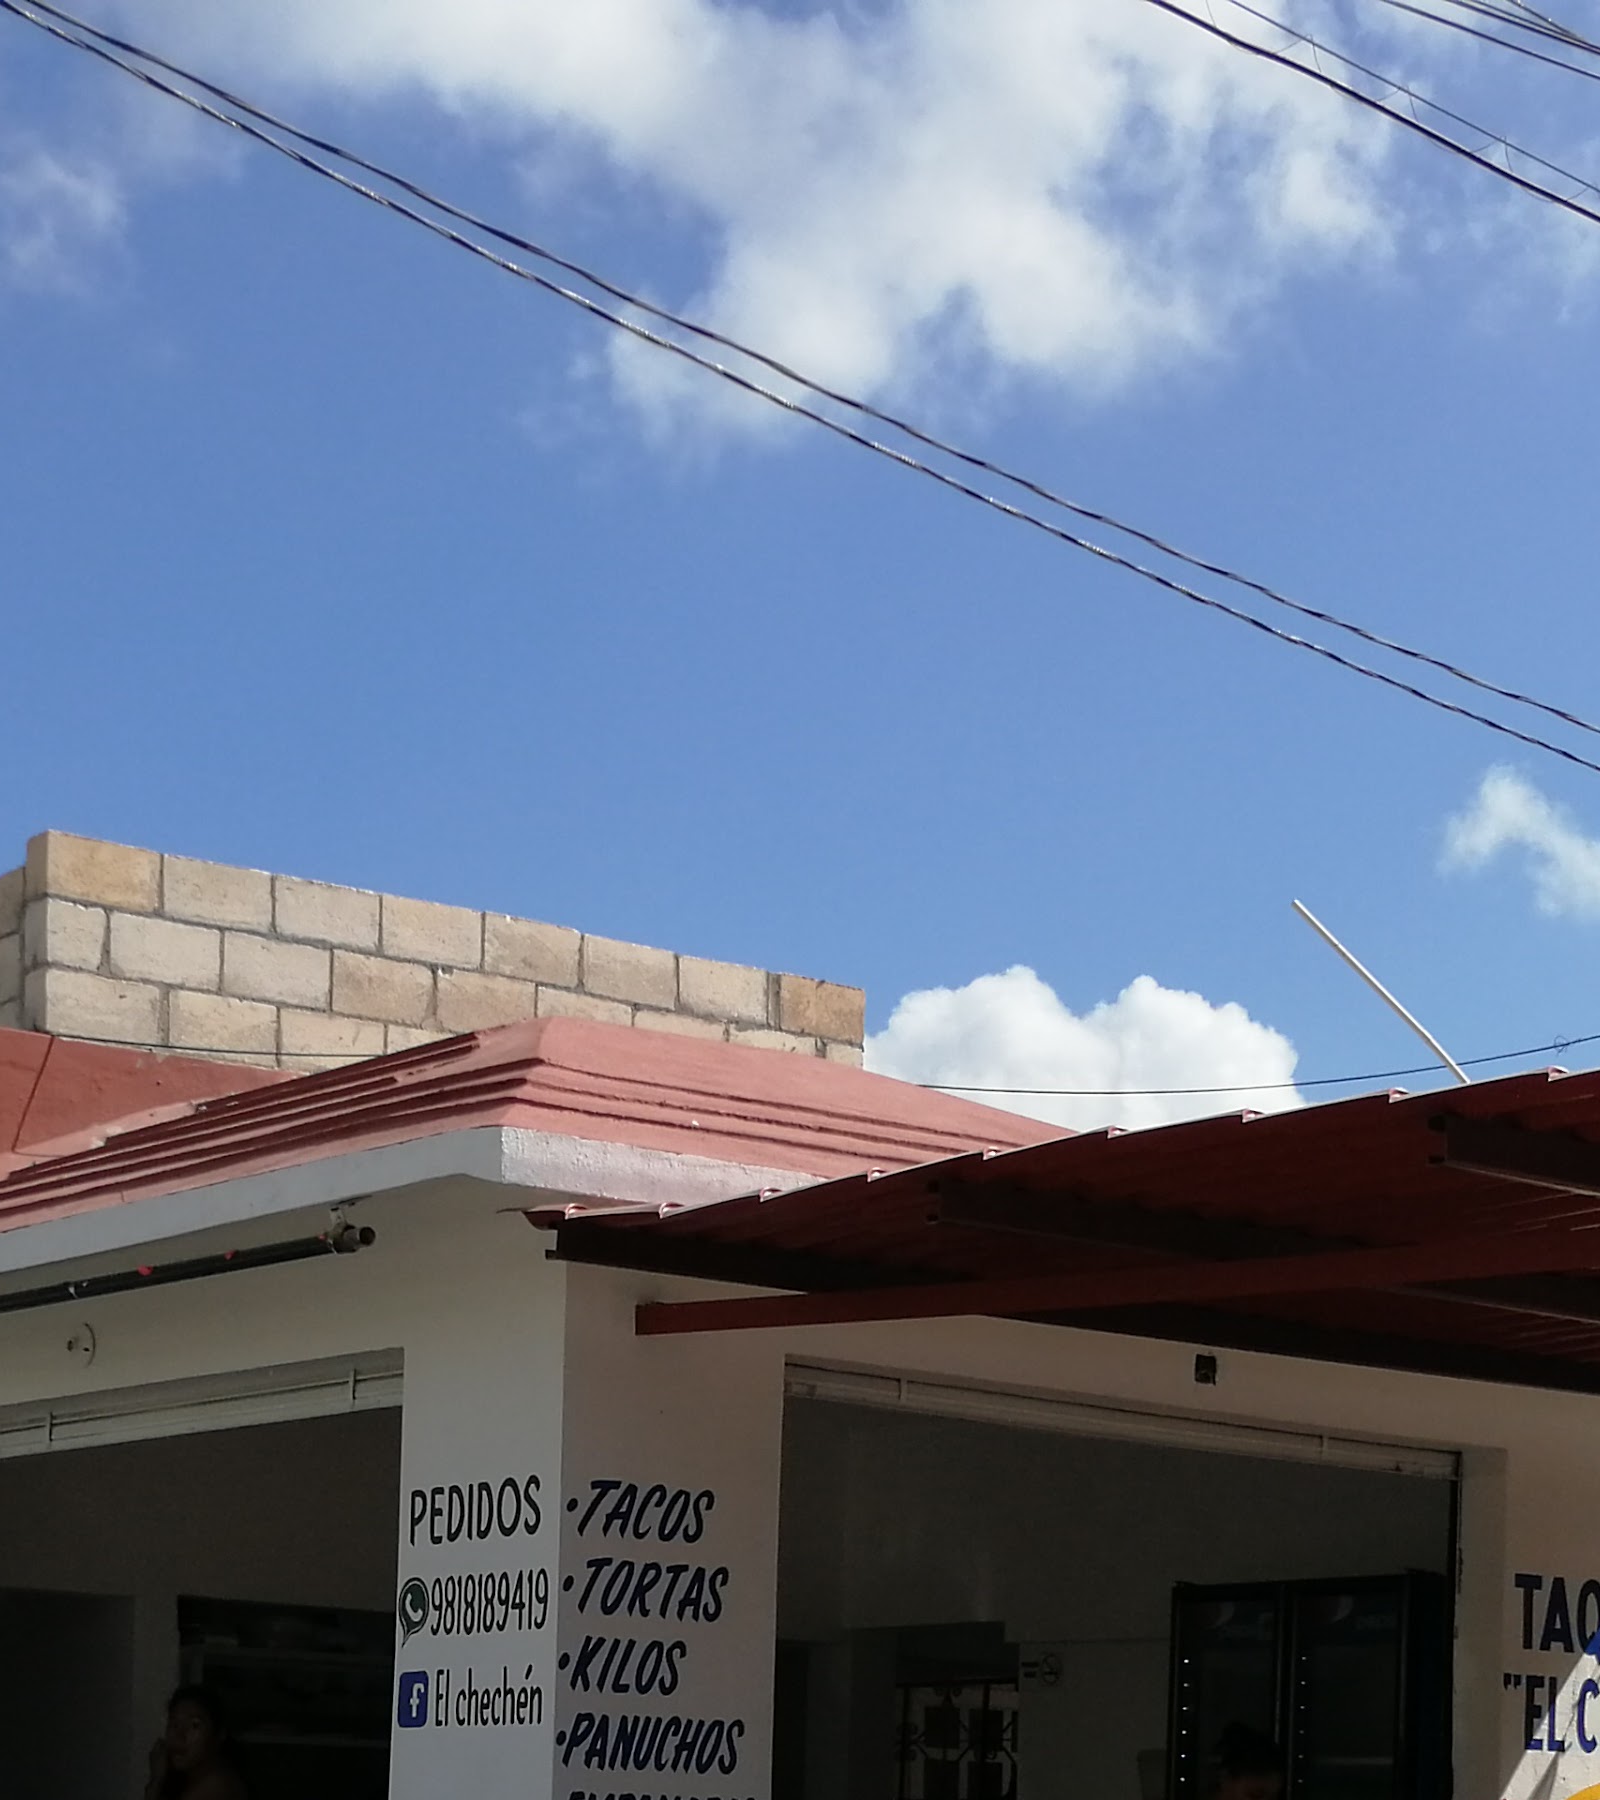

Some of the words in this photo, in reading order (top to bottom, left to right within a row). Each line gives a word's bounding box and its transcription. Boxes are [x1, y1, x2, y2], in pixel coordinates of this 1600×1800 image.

[409, 1474, 543, 1547] PEDIDOS
[577, 1479, 715, 1544] TACOS
[429, 1567, 549, 1636] 9818189419
[577, 1557, 729, 1622] TORTAS
[434, 1669, 451, 1729] El
[455, 1663, 544, 1729] chechén
[569, 1635, 687, 1697] KILOS
[561, 1711, 745, 1776] PANUCHOS
